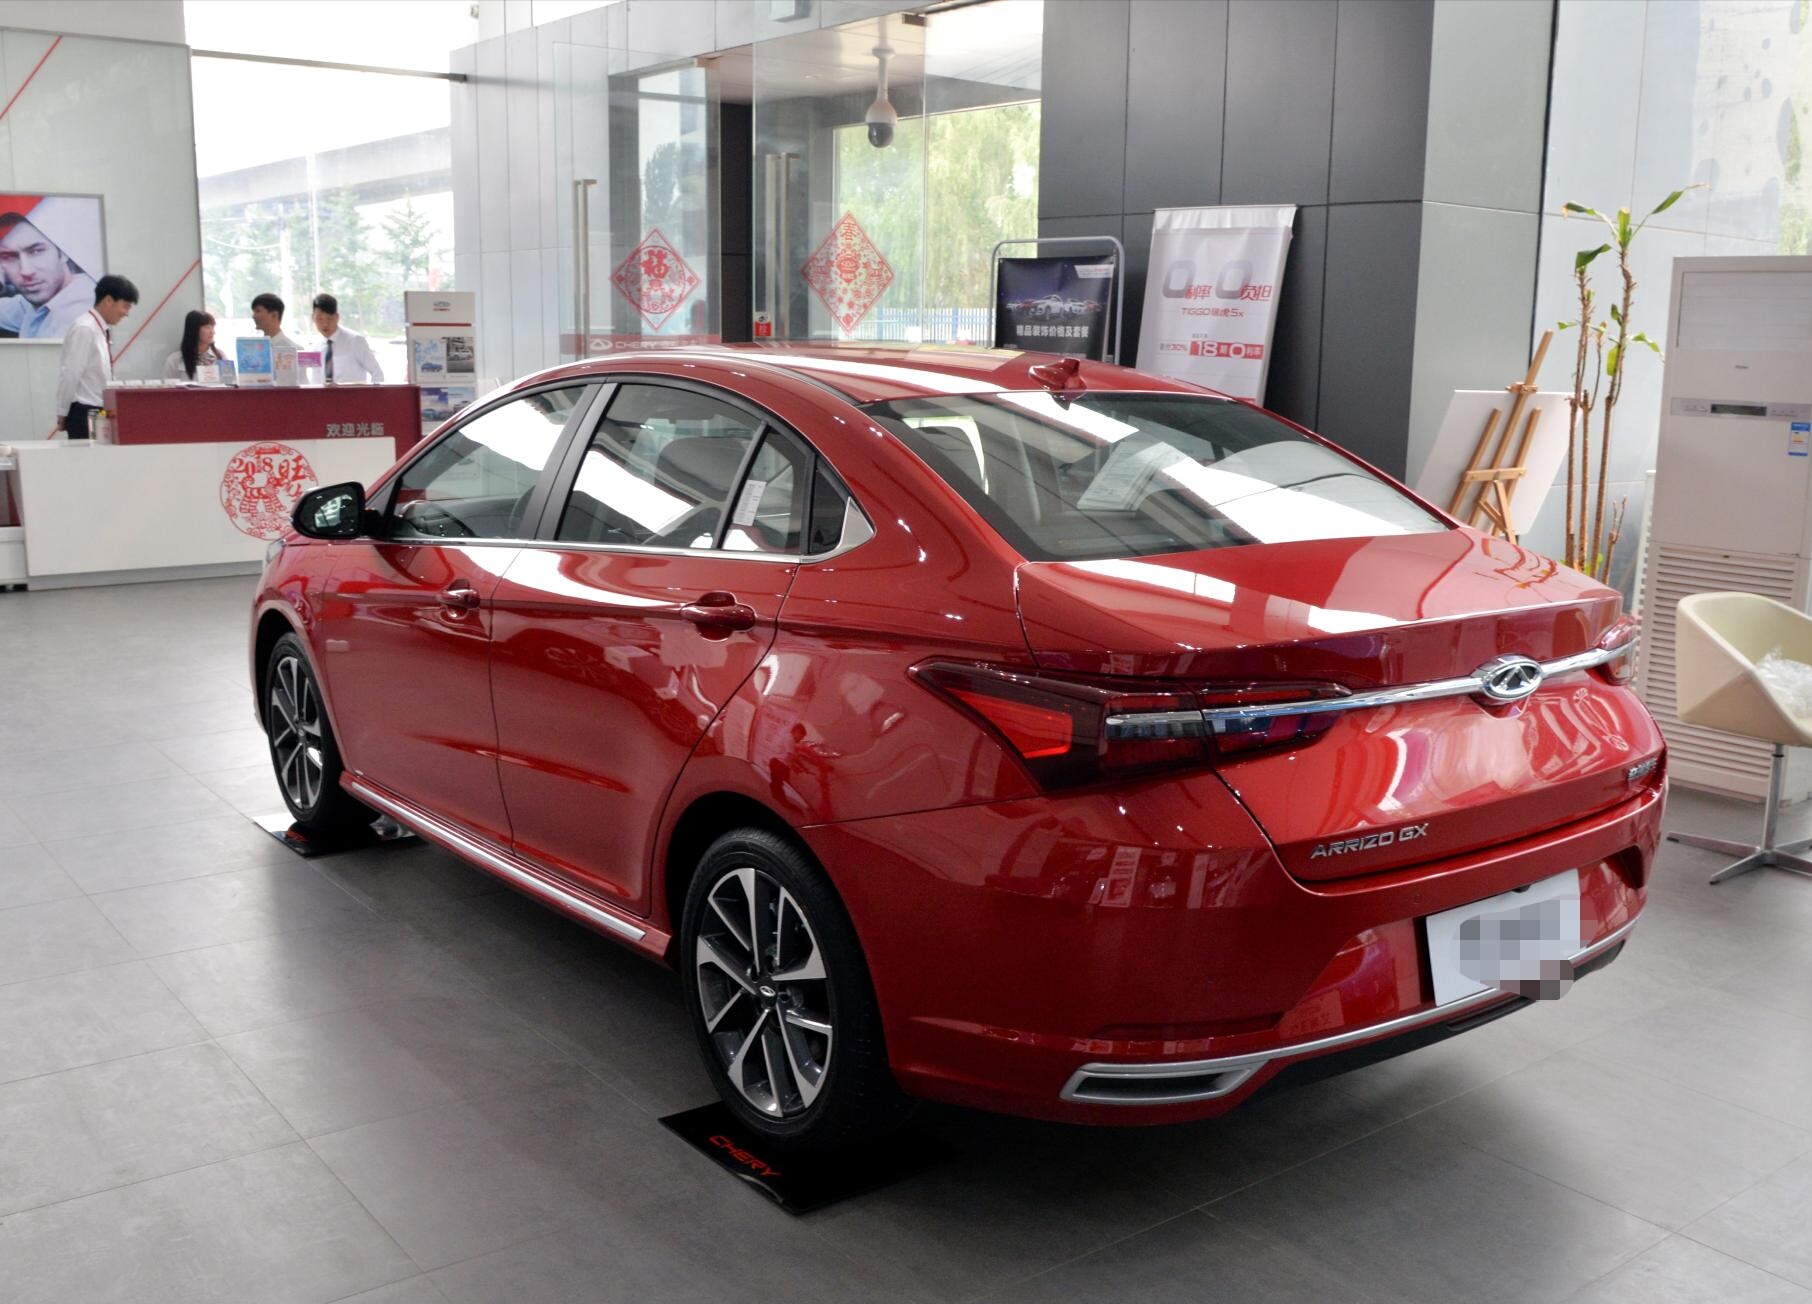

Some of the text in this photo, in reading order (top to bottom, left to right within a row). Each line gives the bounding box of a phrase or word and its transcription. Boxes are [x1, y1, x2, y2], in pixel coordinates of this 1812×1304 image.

[1310, 822, 1429, 859] ARRIZO GX
[709, 1135, 782, 1177] CHERY
